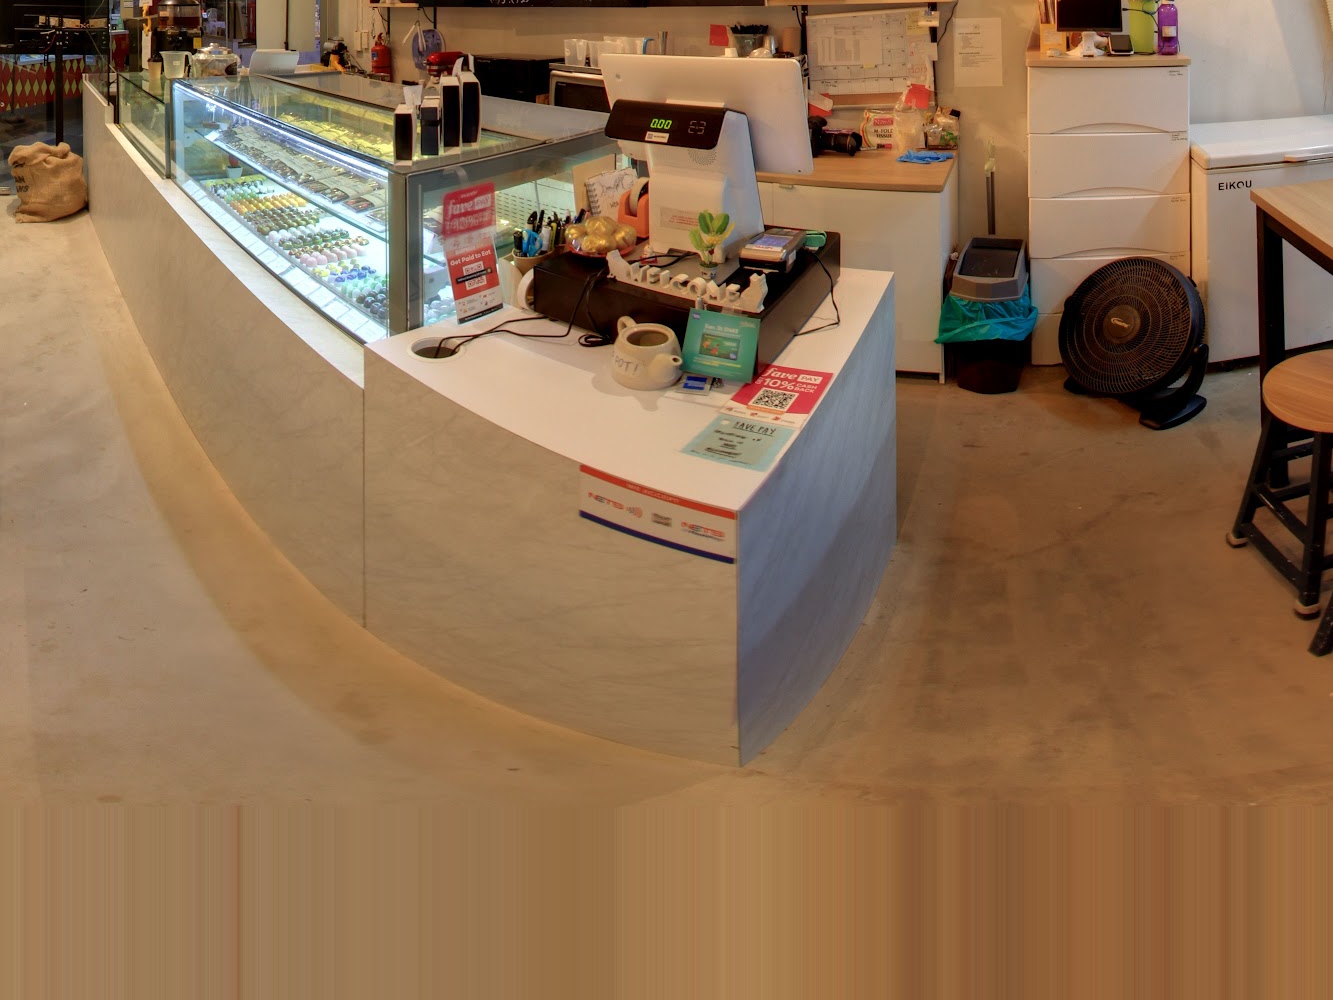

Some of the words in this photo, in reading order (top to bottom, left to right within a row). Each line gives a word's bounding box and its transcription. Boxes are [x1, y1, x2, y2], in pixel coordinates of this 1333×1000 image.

[1218, 180, 1252, 191] EIKOU
[450, 258, 461, 266] Get
[461, 254, 475, 264] Paid
[481, 249, 492, 257] Eat
[630, 261, 742, 304] WELCOME
[761, 367, 799, 380] fave
[800, 374, 820, 383] PAY
[764, 377, 795, 390] 10%
[758, 426, 777, 436] PAY
